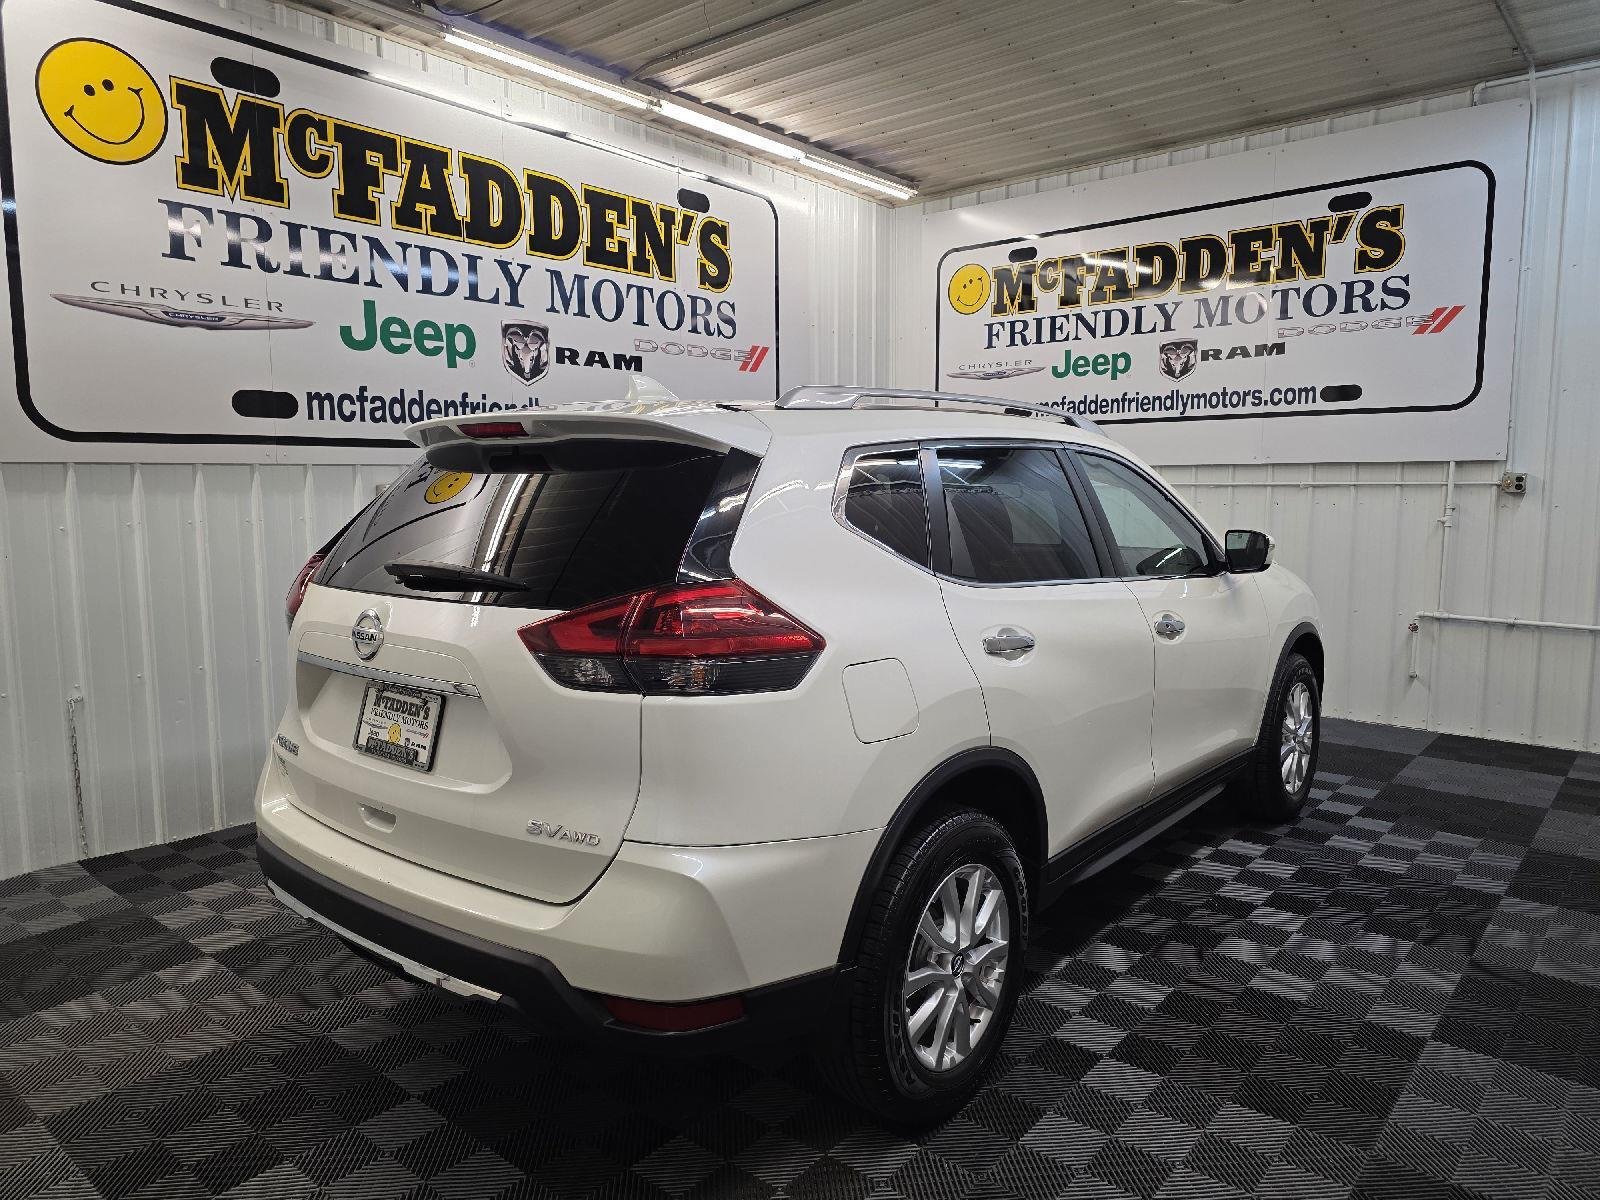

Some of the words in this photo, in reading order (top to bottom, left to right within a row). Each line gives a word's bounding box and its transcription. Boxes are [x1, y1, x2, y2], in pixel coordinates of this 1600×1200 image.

[159, 199, 531, 308] FRIENDLY
[545, 268, 737, 340] MOTORS
[90, 281, 284, 313] CHRYSLER
[983, 300, 1183, 350] FRIENDLY
[1192, 274, 1412, 329] MOTORS
[339, 299, 477, 369] Jeep
[1277, 314, 1434, 339] DODGE
[555, 346, 643, 372] RAM
[634, 338, 752, 363] DODGE
[958, 359, 1033, 371] CHRYSLER
[1051, 349, 1132, 380] Jeep
[1200, 341, 1286, 362] RAM
[306, 385, 540, 424] mcfaddenfri
[1035, 384, 1317, 418] faddenfriendlymotors.com
[526, 819, 563, 838] SV
[560, 829, 601, 847] AWD
